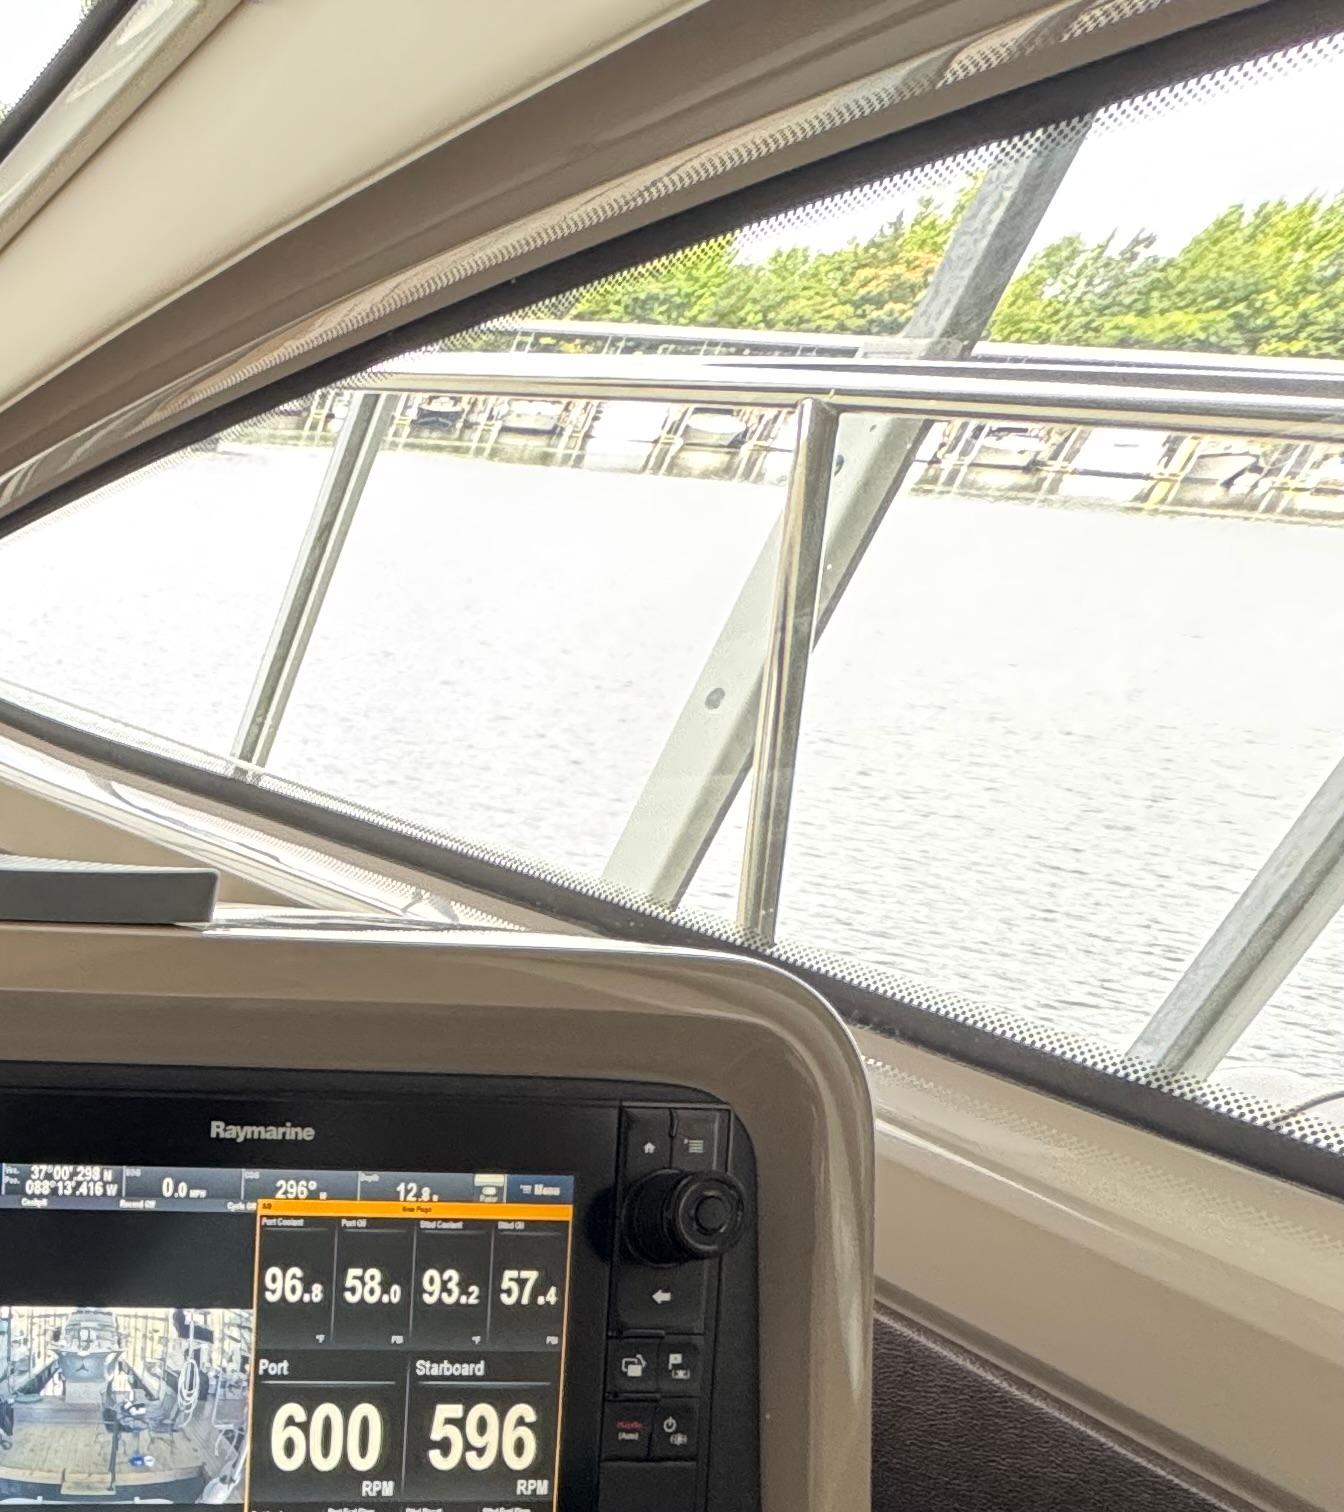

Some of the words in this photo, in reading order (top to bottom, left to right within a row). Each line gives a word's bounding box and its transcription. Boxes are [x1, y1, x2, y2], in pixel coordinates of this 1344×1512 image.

[210, 1120, 315, 1142] Raymarine
[162, 1177, 188, 1198] 0.0
[265, 1266, 324, 1304] 96.8
[344, 1267, 402, 1305] 58.0
[422, 1268, 481, 1305] 93.2
[500, 1269, 558, 1306] 57.4
[258, 1359, 289, 1377] Port
[415, 1360, 486, 1377] Starboard
[271, 1402, 384, 1472] 600
[428, 1402, 538, 1471] 596
[362, 1480, 395, 1497] RPM
[516, 1479, 550, 1496] RPM
